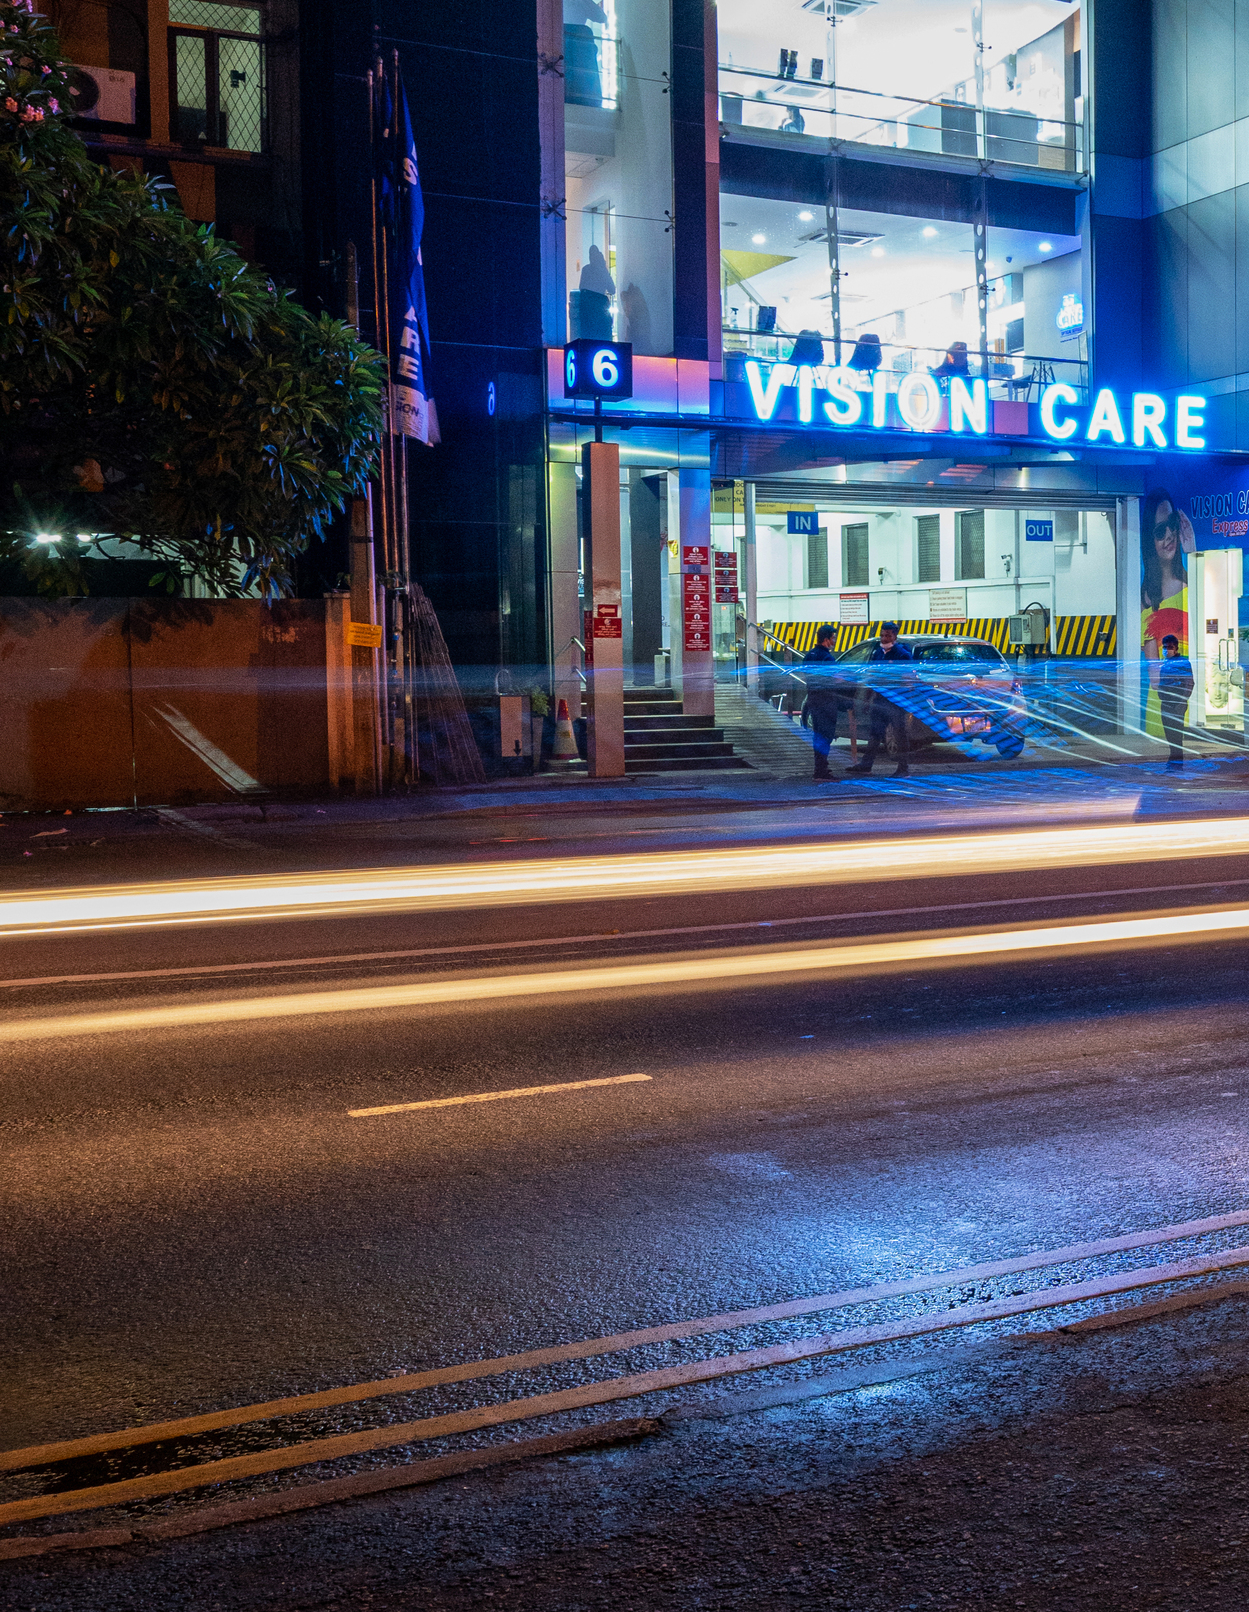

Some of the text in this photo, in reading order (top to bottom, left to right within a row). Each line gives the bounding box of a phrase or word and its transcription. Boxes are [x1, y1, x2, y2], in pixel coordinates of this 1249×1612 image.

[566, 349, 576, 388] 6
[592, 349, 619, 387] 6
[745, 360, 1207, 449] VISION CARE
[1190, 492, 1234, 519] VISION
[795, 515, 812, 531] IN
[1026, 524, 1053, 537] OUT
[1211, 517, 1249, 538] Express
